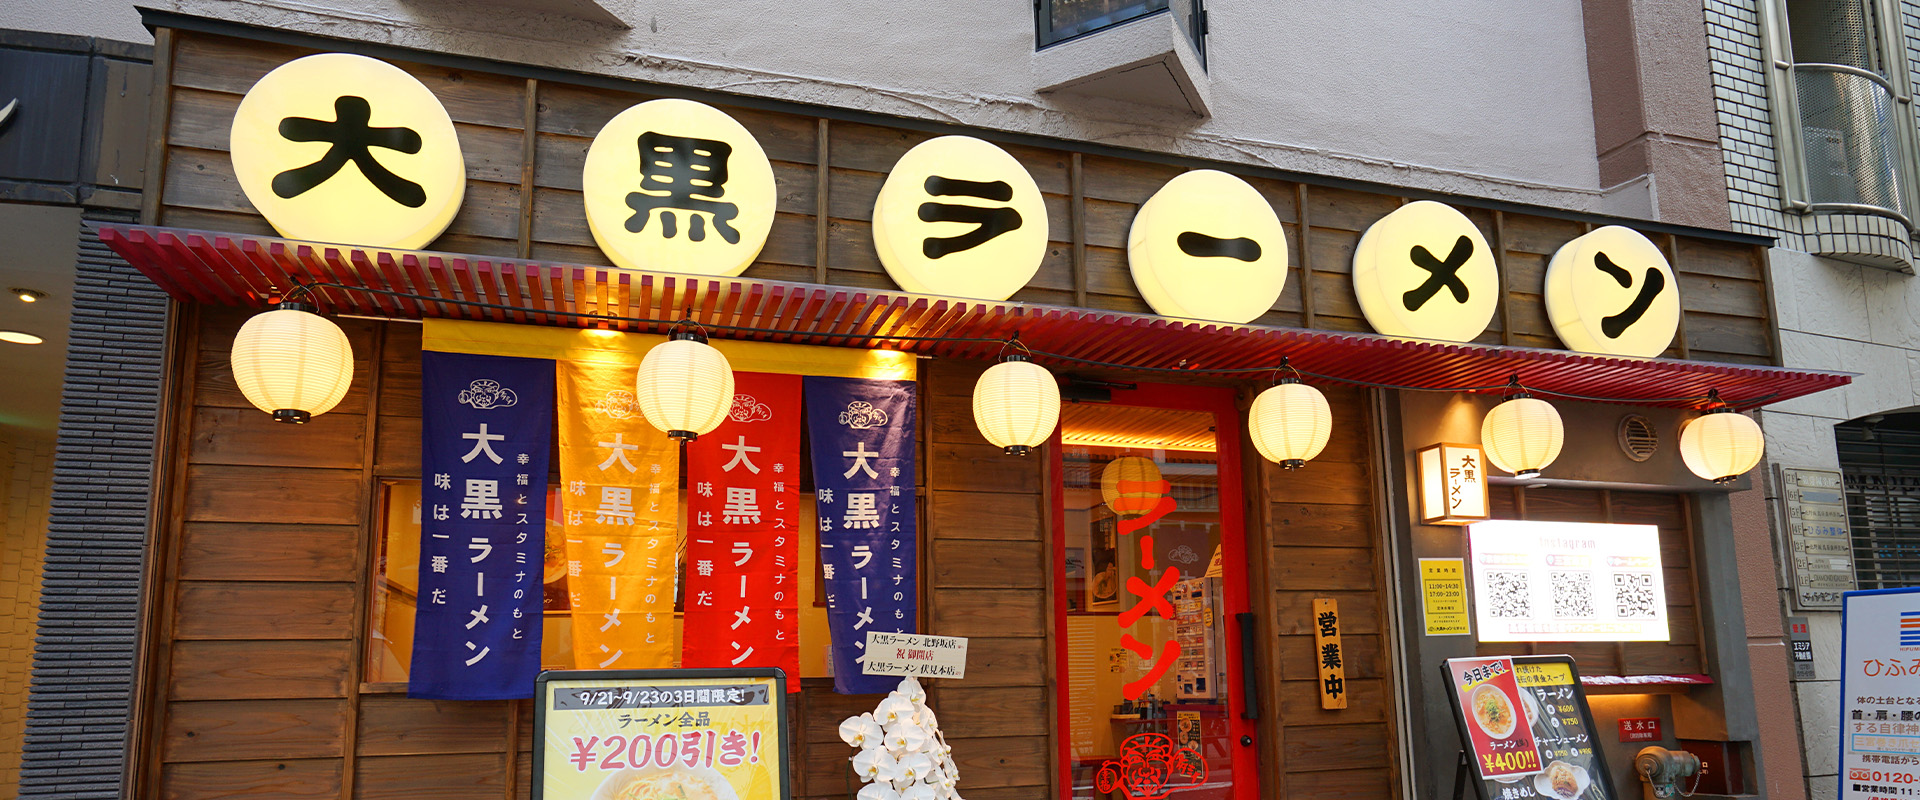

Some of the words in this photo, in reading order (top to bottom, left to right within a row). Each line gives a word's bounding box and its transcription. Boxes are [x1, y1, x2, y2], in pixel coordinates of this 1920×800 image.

[271, 95, 1664, 339] 大黒ラーメン
[1462, 455, 1476, 483] 大黒
[1450, 468, 1462, 509] ラーメン
[431, 473, 451, 604] 味は一番だ
[461, 423, 504, 666] 大黒ラーメン
[512, 453, 530, 639] 幸福とスタミナのもと
[595, 433, 639, 668] 大黒ラーメン
[645, 463, 661, 644] 幸福とスタミナのもと
[697, 482, 714, 606] 味は一番だ
[721, 435, 761, 665] 大黒ラーメン
[773, 463, 785, 640] 幸福とスタミナのもと
[1113, 479, 1181, 701] ラーメン
[871, 634, 920, 646] 大黒ラーメン
[923, 638, 957, 649] 北野坂店
[896, 648, 905, 660] 祝
[1318, 611, 1343, 699] 営業中
[867, 661, 917, 673] 大黒ラーメン
[921, 664, 956, 675] 伏見本店
[1463, 660, 1505, 686] 今日まで!
[1537, 688, 1574, 701] ラーメン
[618, 711, 711, 729] ラーメン全品
[1624, 720, 1656, 731] 送水口
[569, 730, 761, 772] ¥200引き!
[1535, 733, 1588, 747] チャーシューメン
[1483, 750, 1537, 773] ¥400!!
[1862, 754, 1920, 766] 携帯電話から
[1502, 786, 1536, 800] 焼きめし
[1861, 784, 1898, 795] 営業時間
